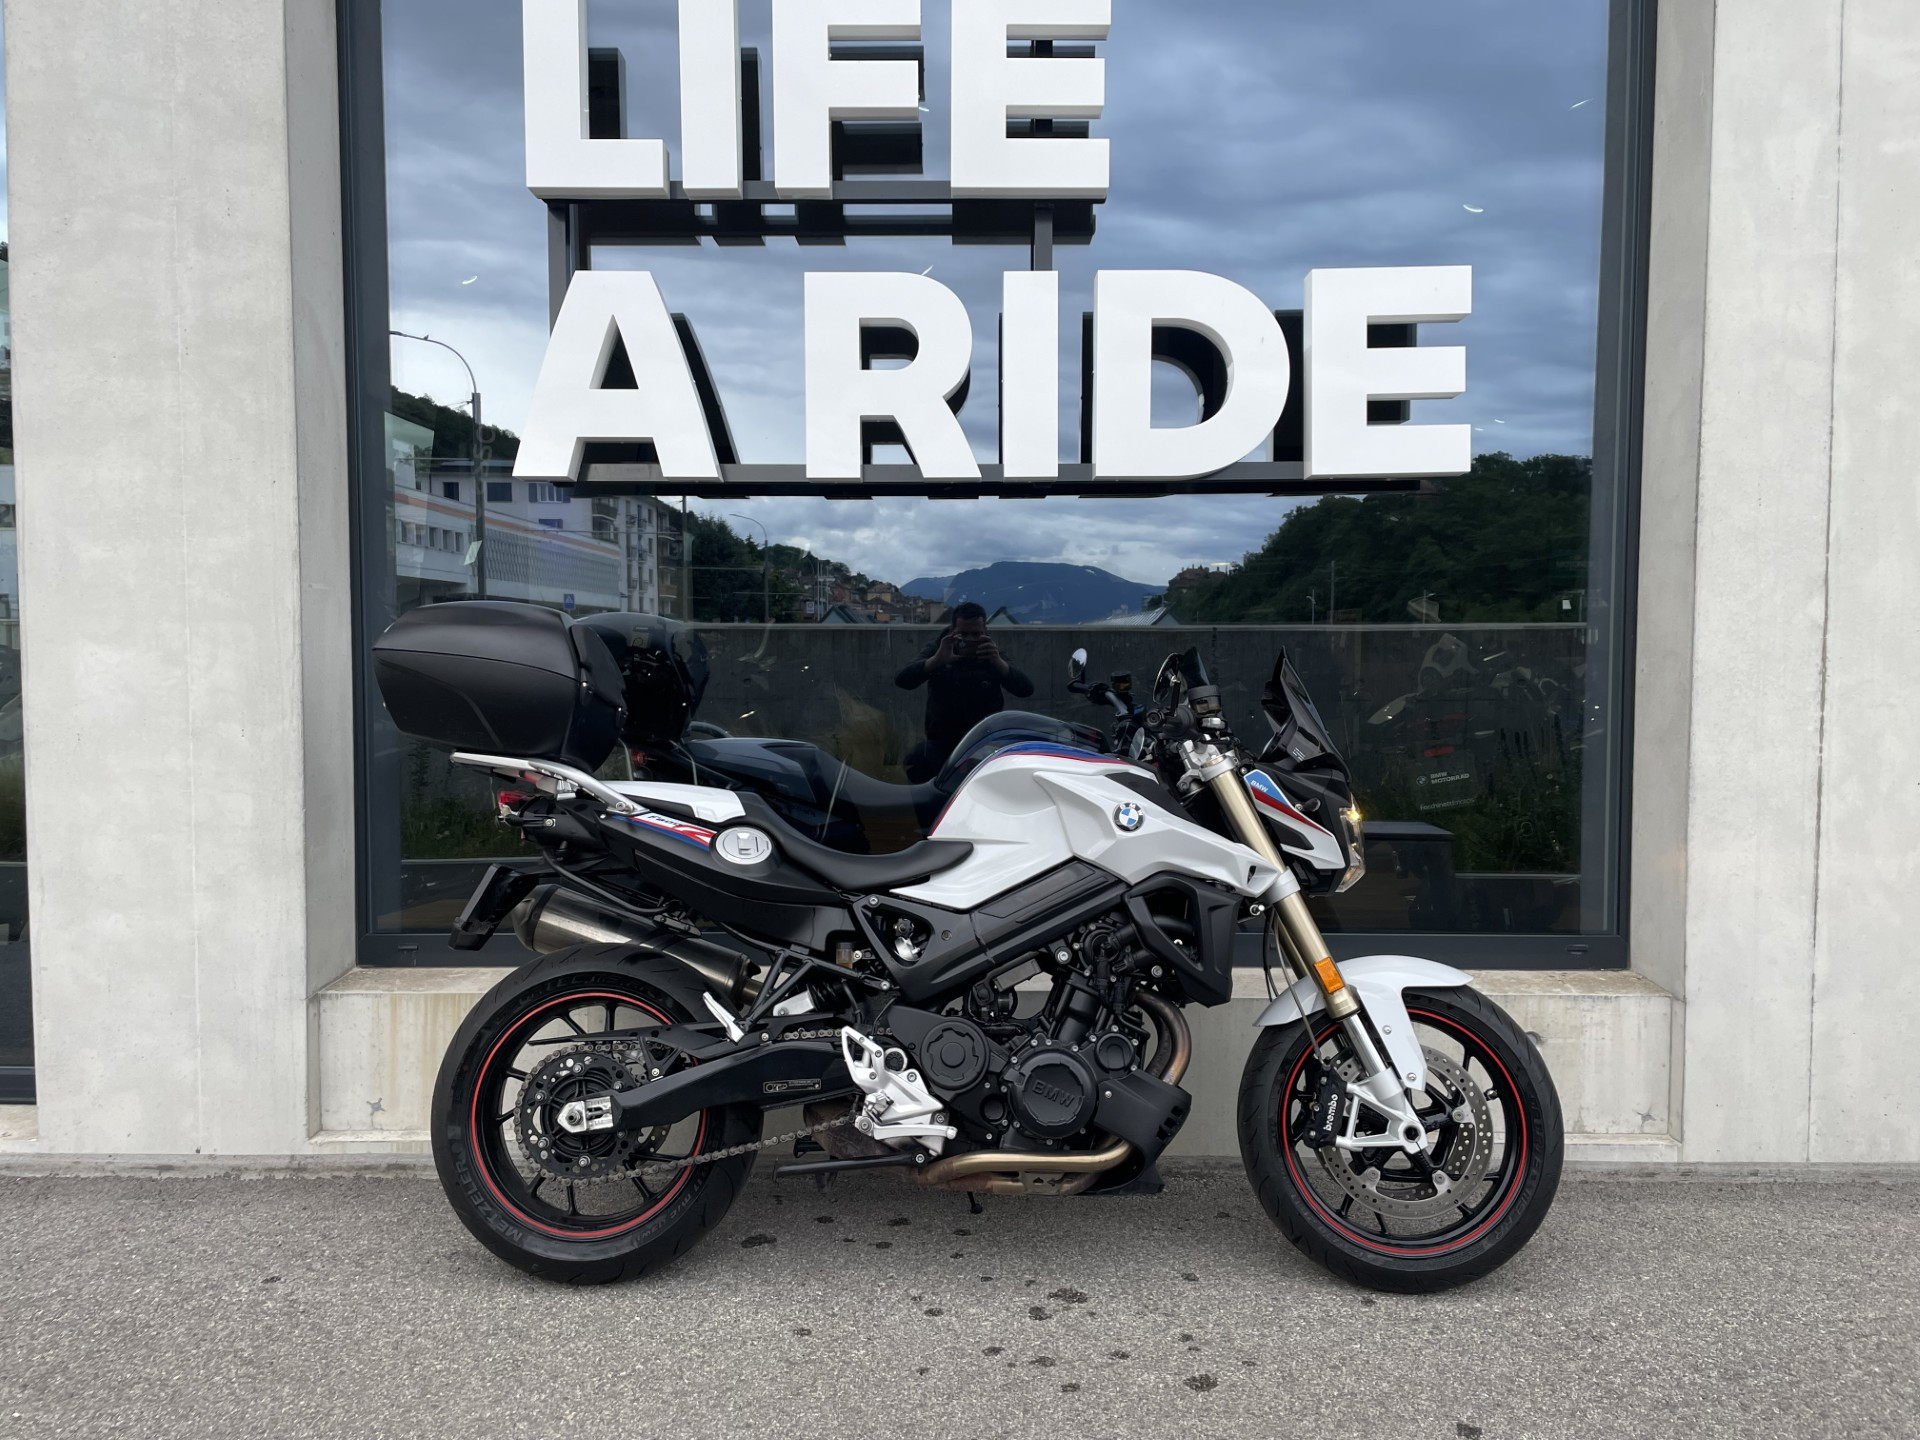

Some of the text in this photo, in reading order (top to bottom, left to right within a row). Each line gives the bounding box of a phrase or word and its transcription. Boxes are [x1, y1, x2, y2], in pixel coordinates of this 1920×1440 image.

[523, 0, 1110, 200] LIFE
[513, 266, 1472, 481] A RIDE
[1250, 780, 1269, 793] BMW
[1430, 771, 1448, 780] BMW
[1431, 773, 1470, 785] MOTORRAD
[1031, 1079, 1076, 1108] BMW
[1322, 1094, 1339, 1132] brembo
[455, 1157, 524, 1243] METZELER
